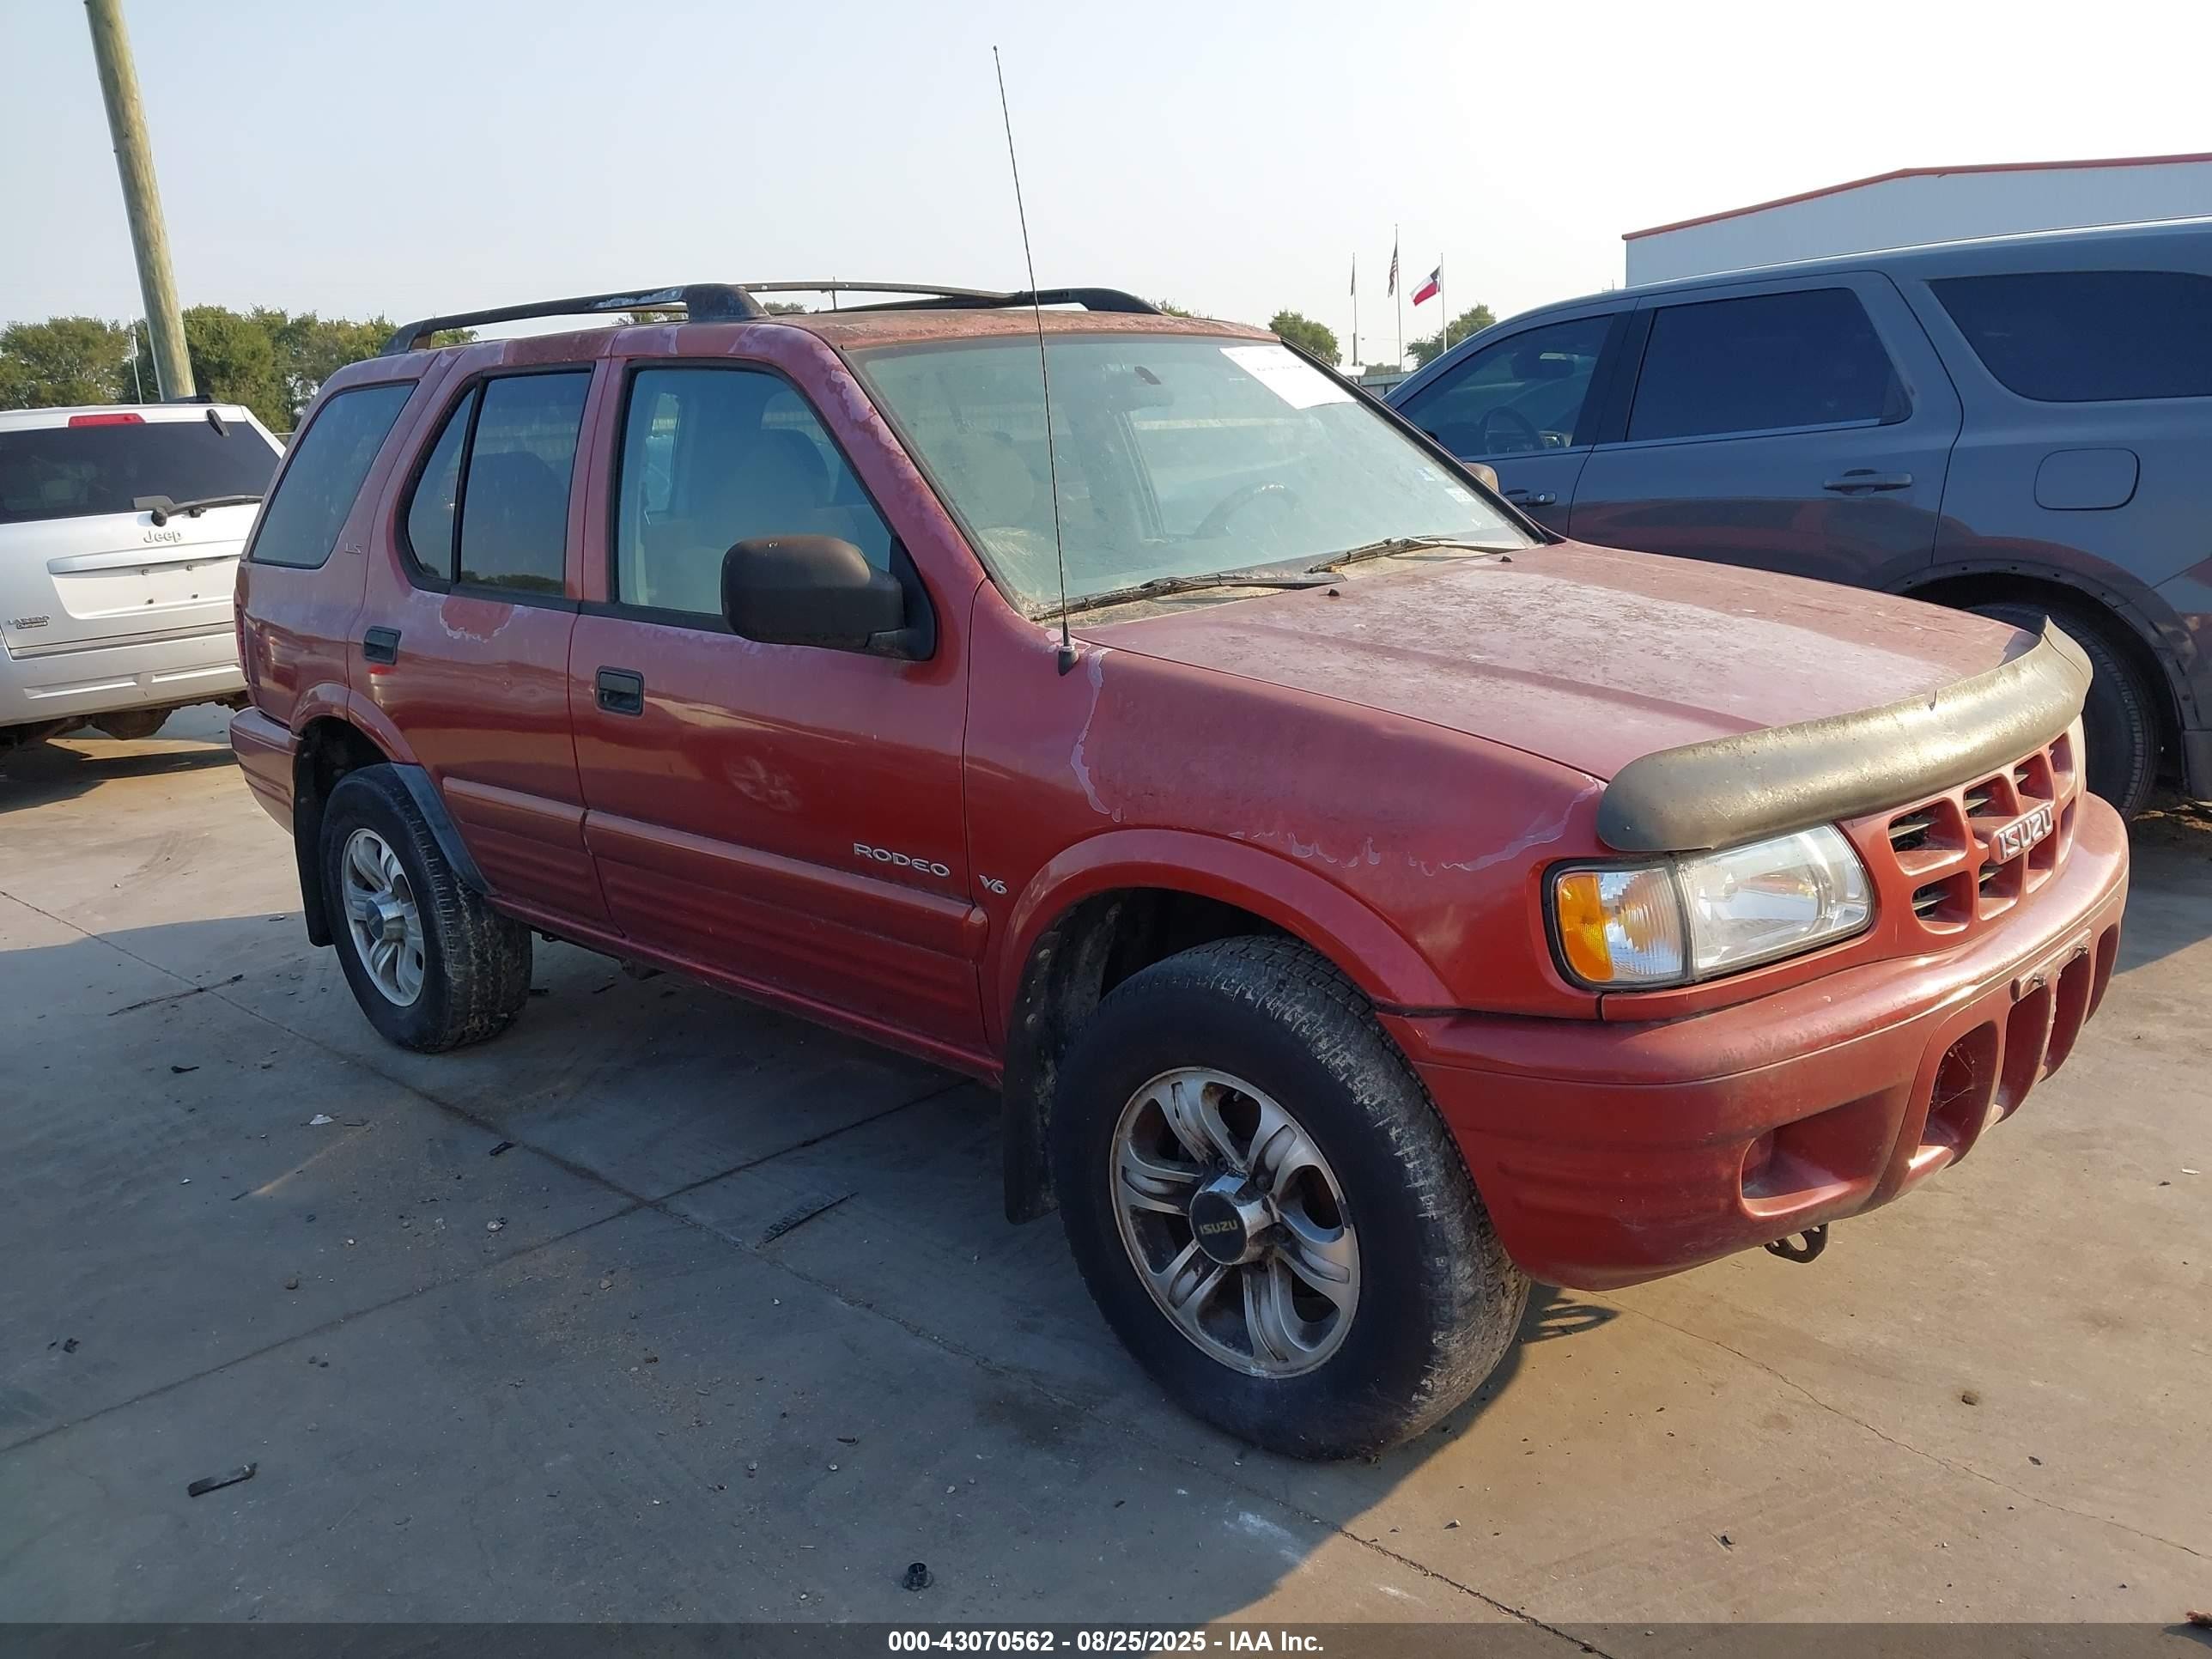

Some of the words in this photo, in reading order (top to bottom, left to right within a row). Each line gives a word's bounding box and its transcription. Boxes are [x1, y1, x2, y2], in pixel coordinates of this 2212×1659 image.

[143, 530, 182, 544] Jeep
[1998, 806, 2054, 860] ISUZU
[853, 842, 951, 878] RODEO
[978, 874, 1008, 895] V6
[1199, 1219, 1238, 1235] ISUZU
